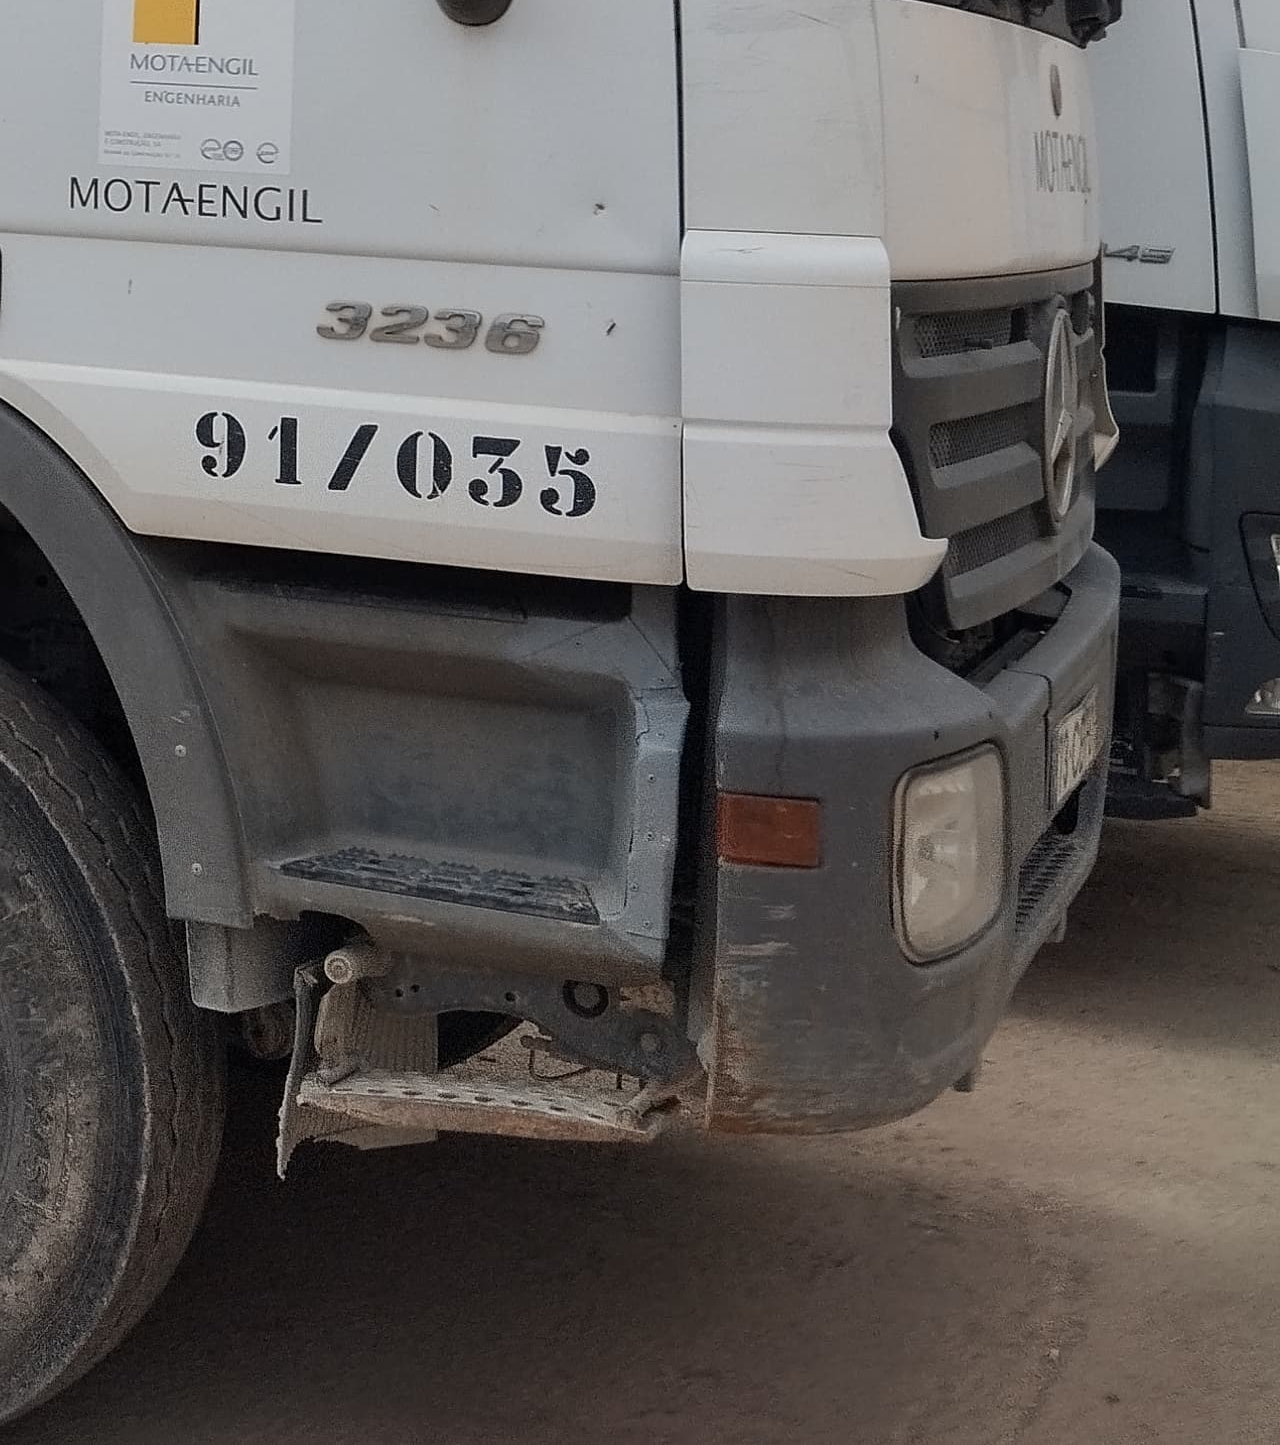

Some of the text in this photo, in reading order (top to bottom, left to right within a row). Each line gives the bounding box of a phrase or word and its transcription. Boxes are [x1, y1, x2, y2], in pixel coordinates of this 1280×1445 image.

[144, 91, 241, 107] ENGENHARIA
[316, 302, 545, 354] 3236
[196, 411, 596, 517] 91/035
